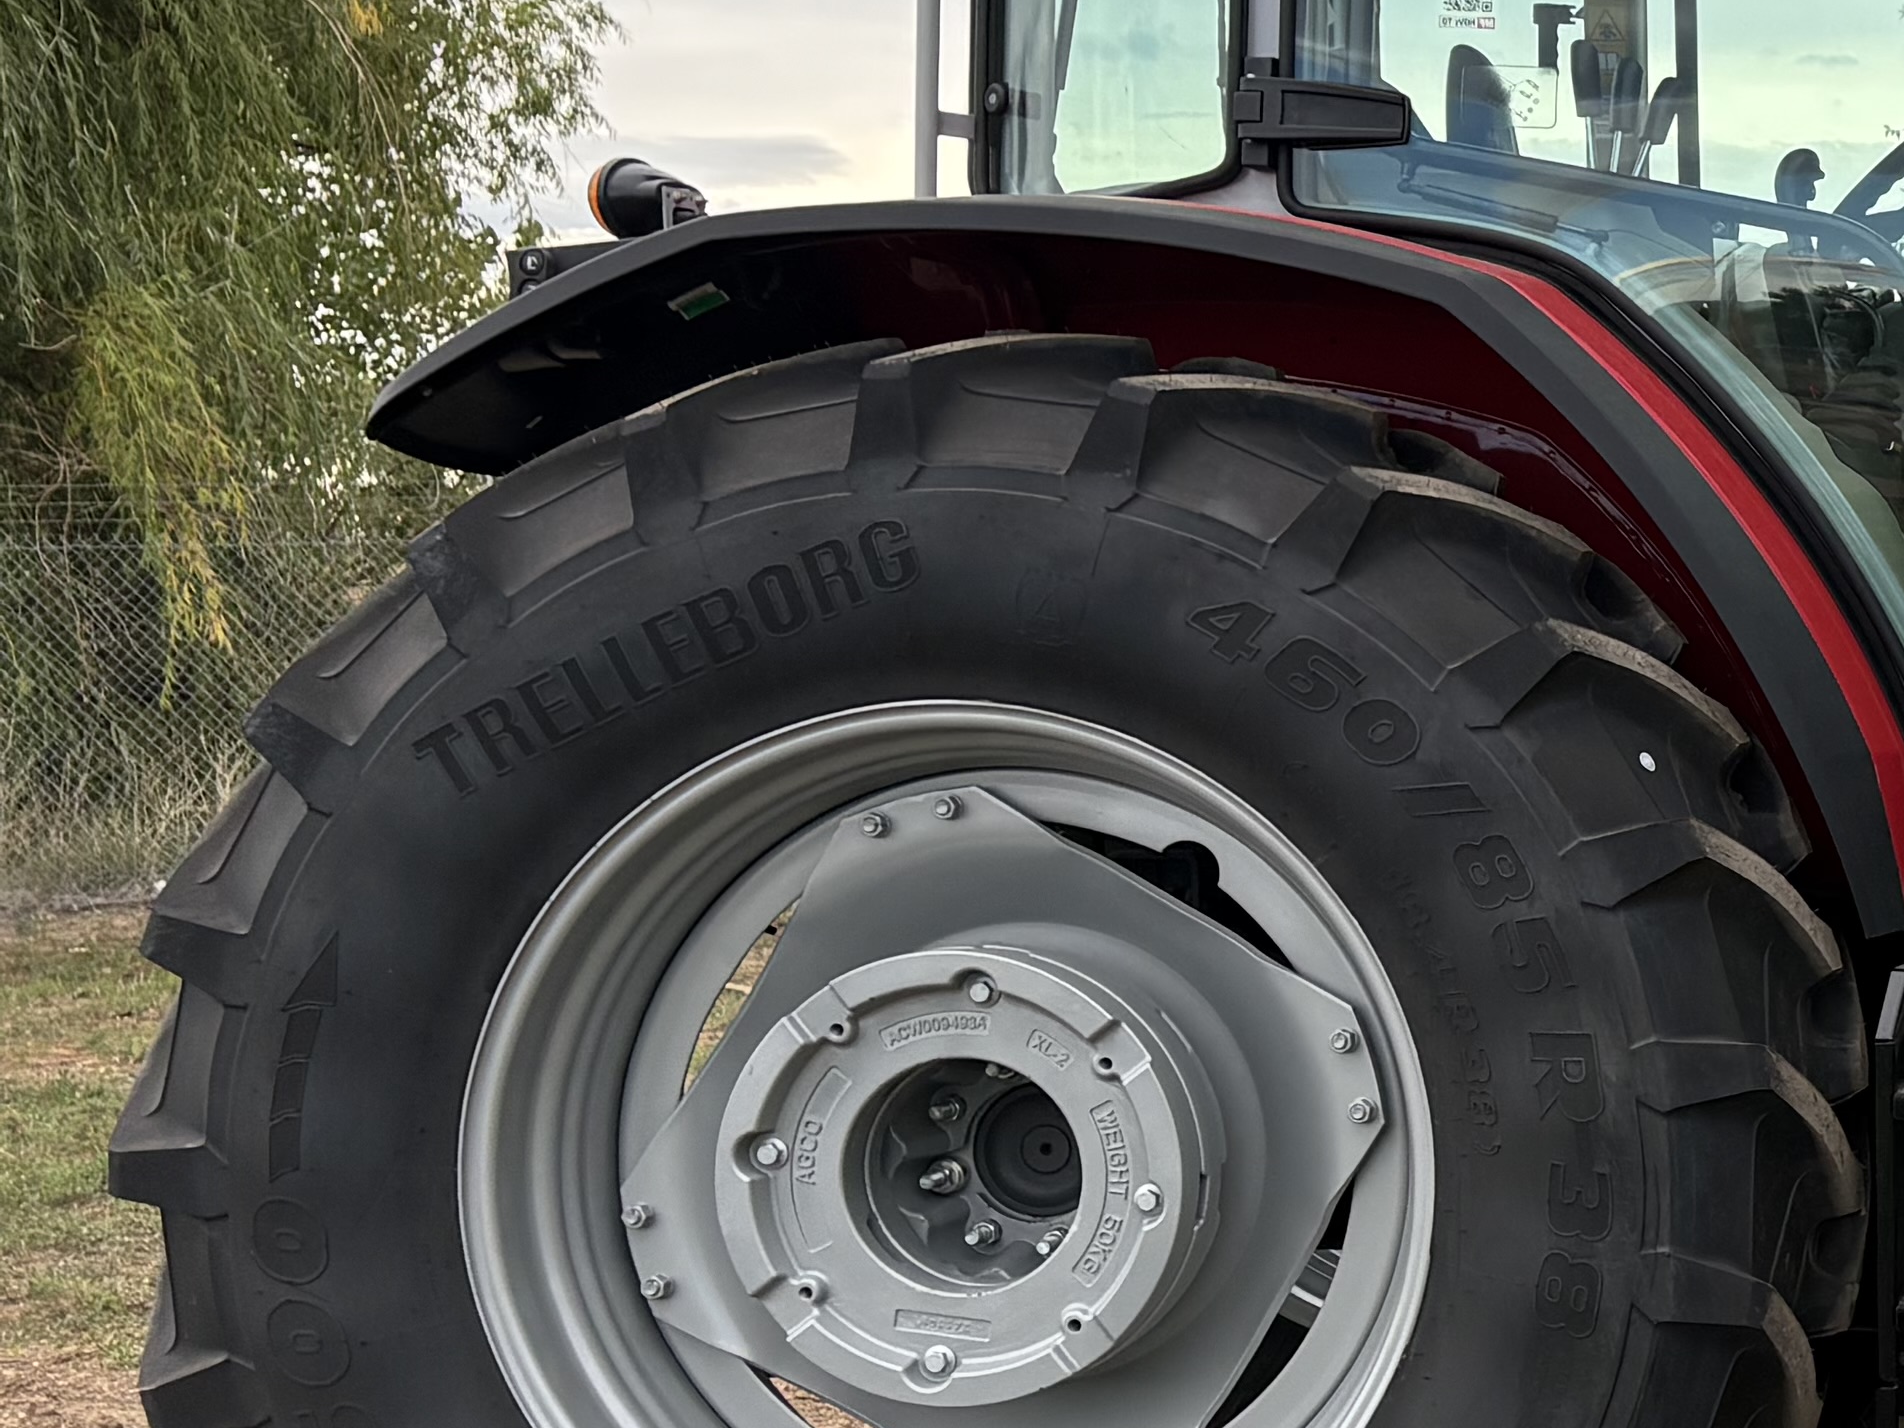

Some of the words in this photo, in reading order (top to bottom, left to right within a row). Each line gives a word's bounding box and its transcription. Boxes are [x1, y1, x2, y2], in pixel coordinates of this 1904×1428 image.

[412, 519, 921, 798] TRELLEBORG
[1187, 601, 1577, 994] 460/85
[1031, 1035, 1071, 1068] XL-2
[1529, 1030, 1606, 1123] R
[795, 1120, 823, 1186] AGCO
[1097, 1110, 1130, 1201] WEIGHT
[1082, 1215, 1123, 1274] 50KG
[1534, 1161, 1615, 1338] 38
